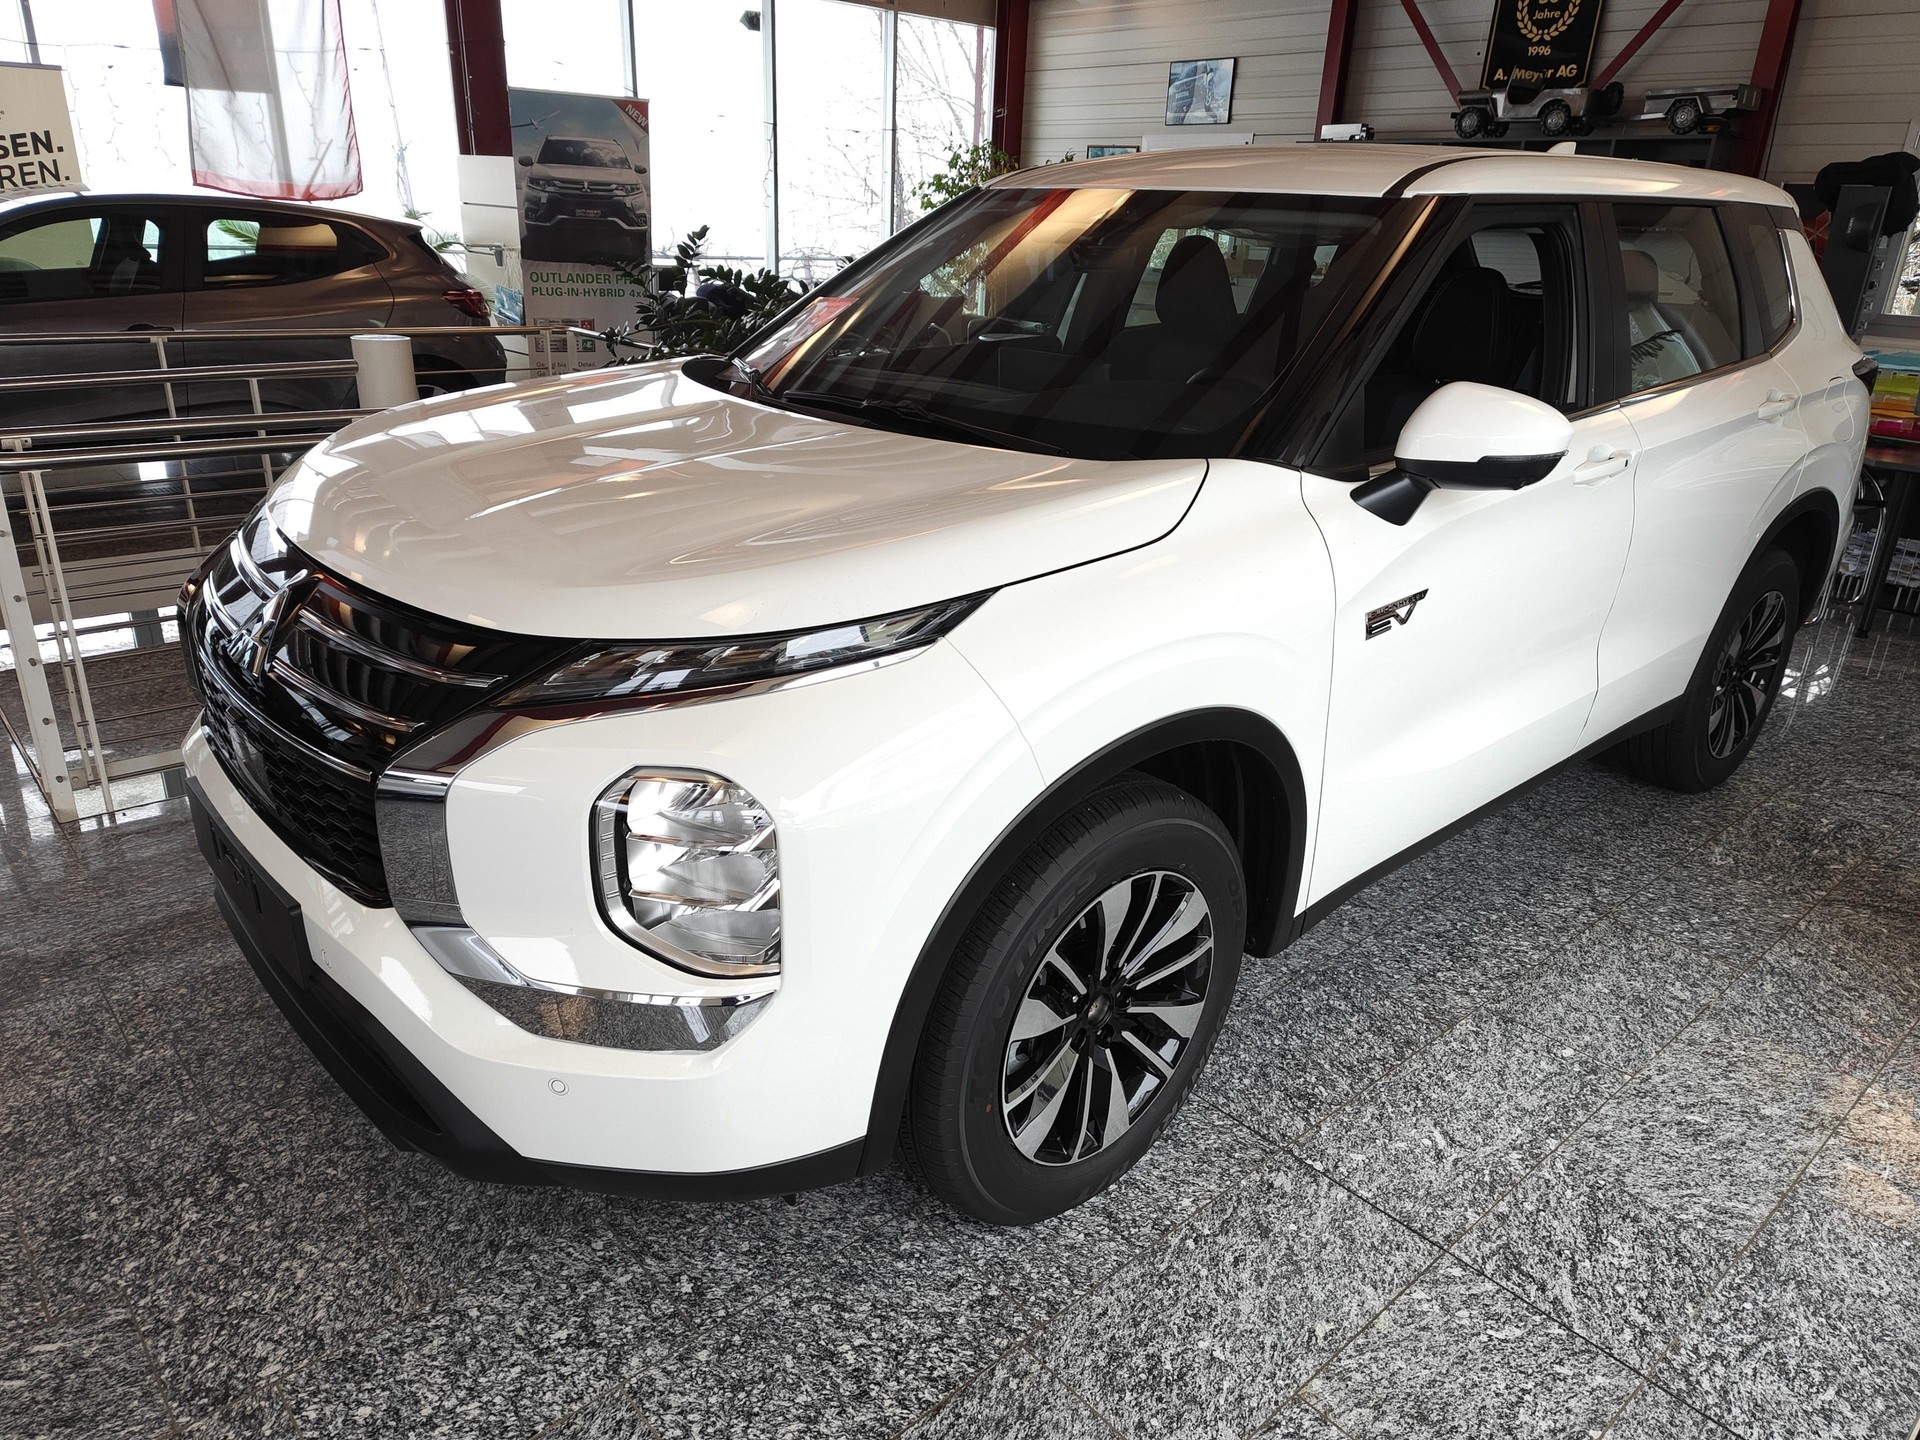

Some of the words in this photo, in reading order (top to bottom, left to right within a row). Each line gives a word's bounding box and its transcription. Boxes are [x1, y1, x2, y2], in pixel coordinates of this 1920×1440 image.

[1533, 8, 1561, 20] Jahre
[1528, 45, 1551, 56] 1996
[1493, 68, 1508, 81] A.
[1513, 68, 1554, 83] Meyr
[1556, 64, 1578, 78] AG
[625, 103, 648, 127] NEW
[529, 271, 611, 285] OUTLANDER
[531, 287, 625, 298] PLUG-IN-HYBRID
[1365, 596, 1420, 641] EV
